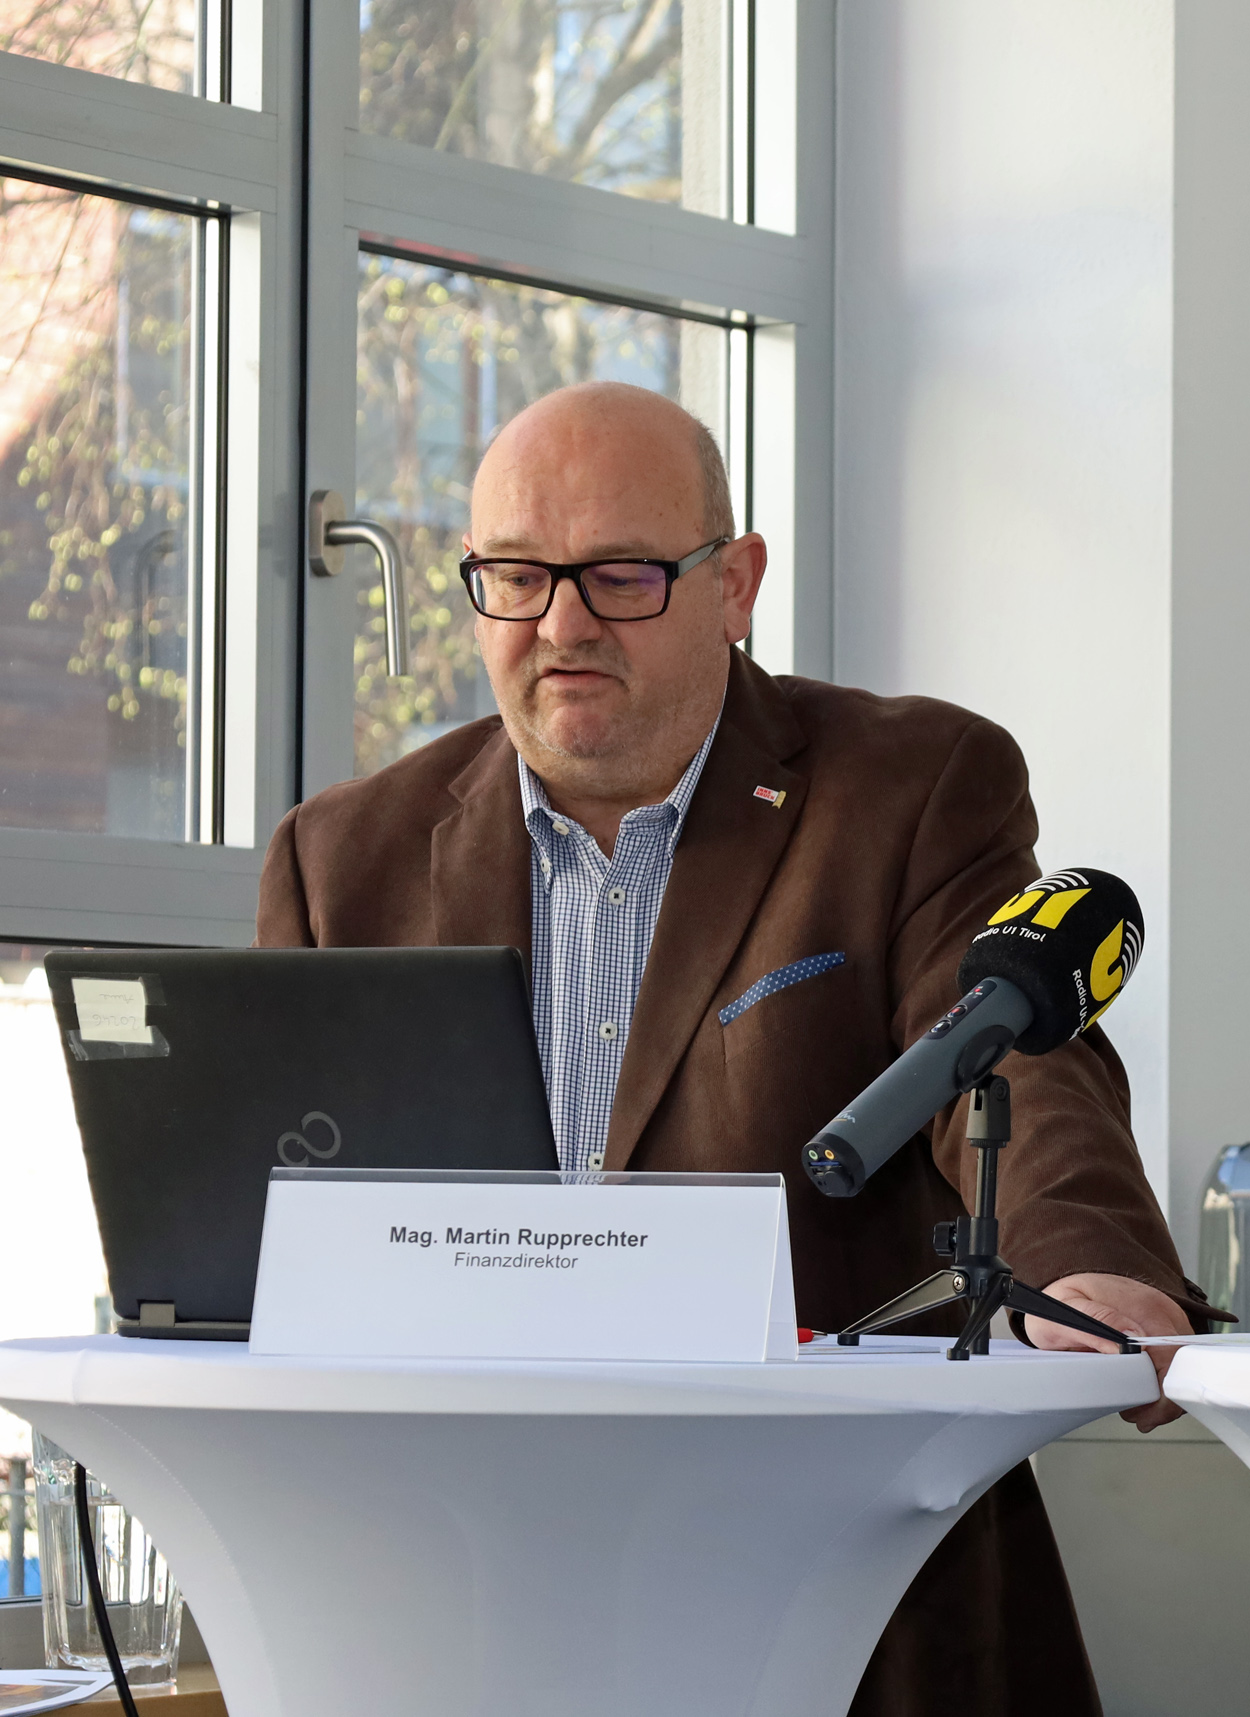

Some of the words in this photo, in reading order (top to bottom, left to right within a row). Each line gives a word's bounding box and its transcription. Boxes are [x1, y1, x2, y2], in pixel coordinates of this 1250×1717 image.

[1002, 926, 1018, 935] U1
[1019, 927, 1047, 942] Tirol
[1072, 968, 1088, 1006] Radio
[389, 1226, 438, 1247] Mag.
[445, 1227, 510, 1245] Martin
[517, 1228, 648, 1250] Rupprechter
[454, 1252, 578, 1269] Finanzdirektor
